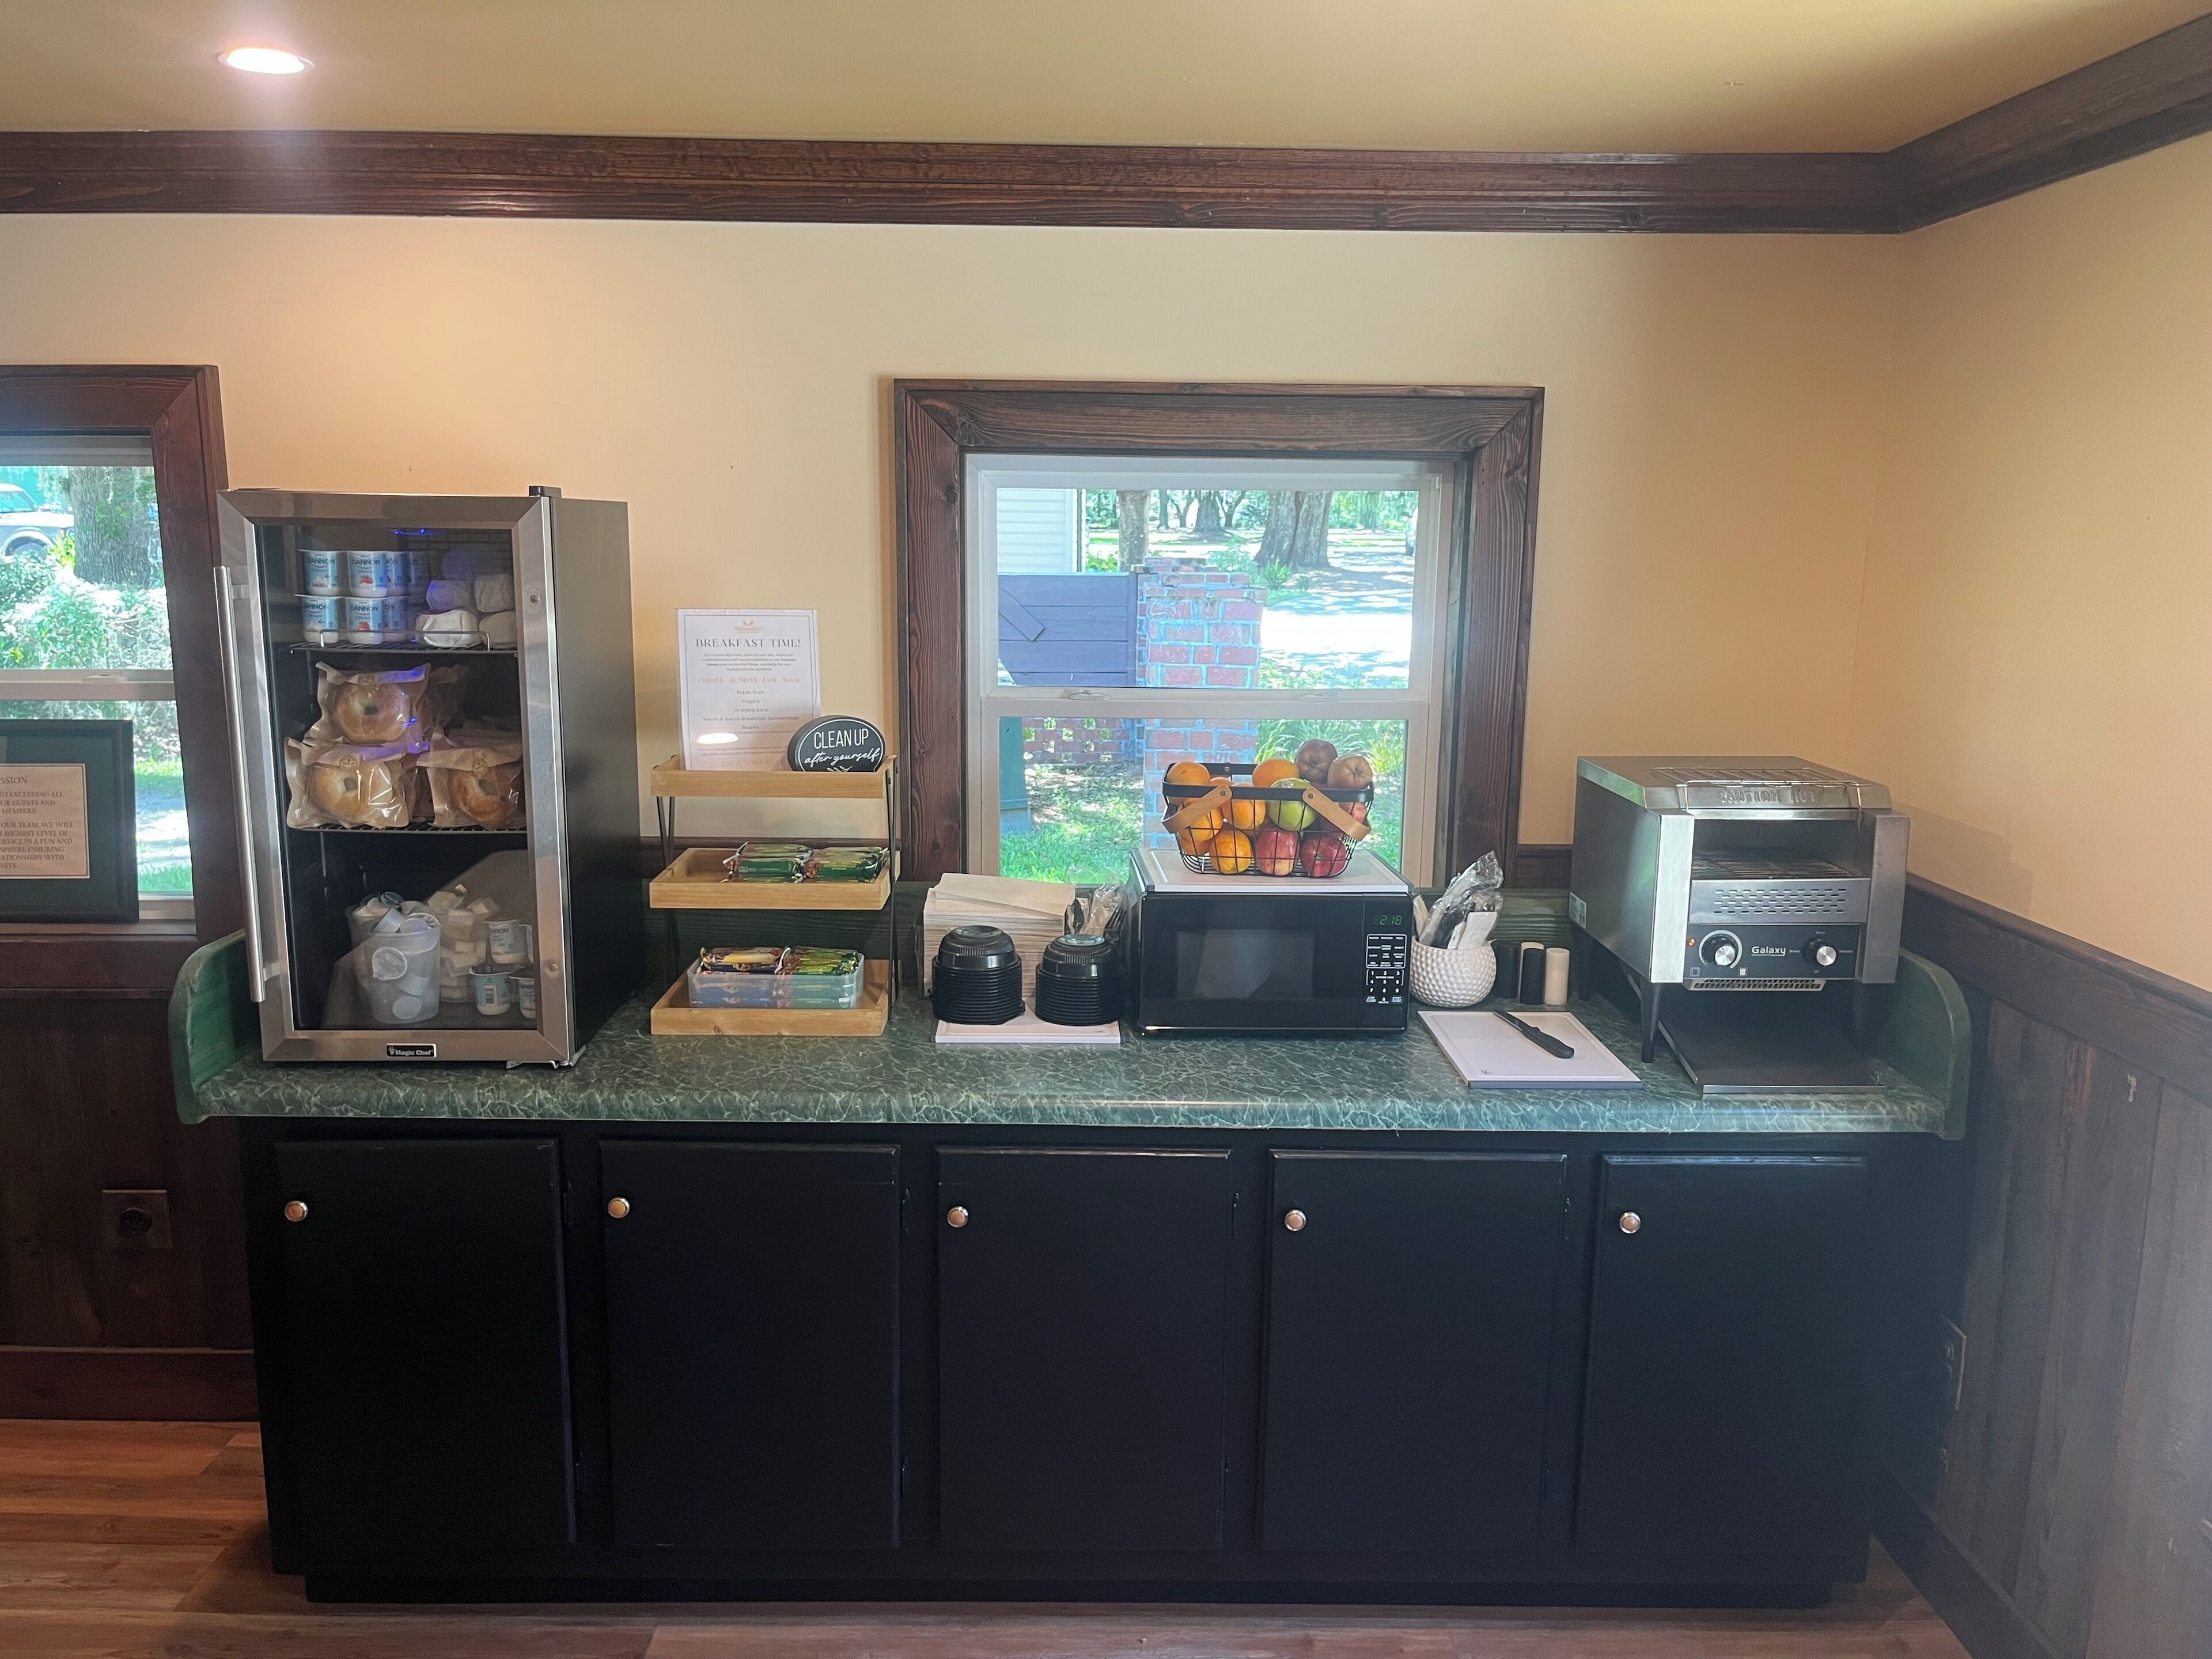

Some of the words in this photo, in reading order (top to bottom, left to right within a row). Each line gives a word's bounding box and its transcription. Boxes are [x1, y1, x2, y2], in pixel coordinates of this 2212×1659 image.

[696, 639, 765, 647] BREAKFAST
[770, 639, 801, 647] TIME!
[814, 730, 852, 749] CLEAN
[854, 728, 869, 746] UP
[804, 751, 832, 768] after
[830, 748, 881, 766] yourself
[1719, 789, 1780, 803] CAUTION
[1790, 790, 1816, 803] HOT
[1751, 945, 1786, 957] Galaxy
